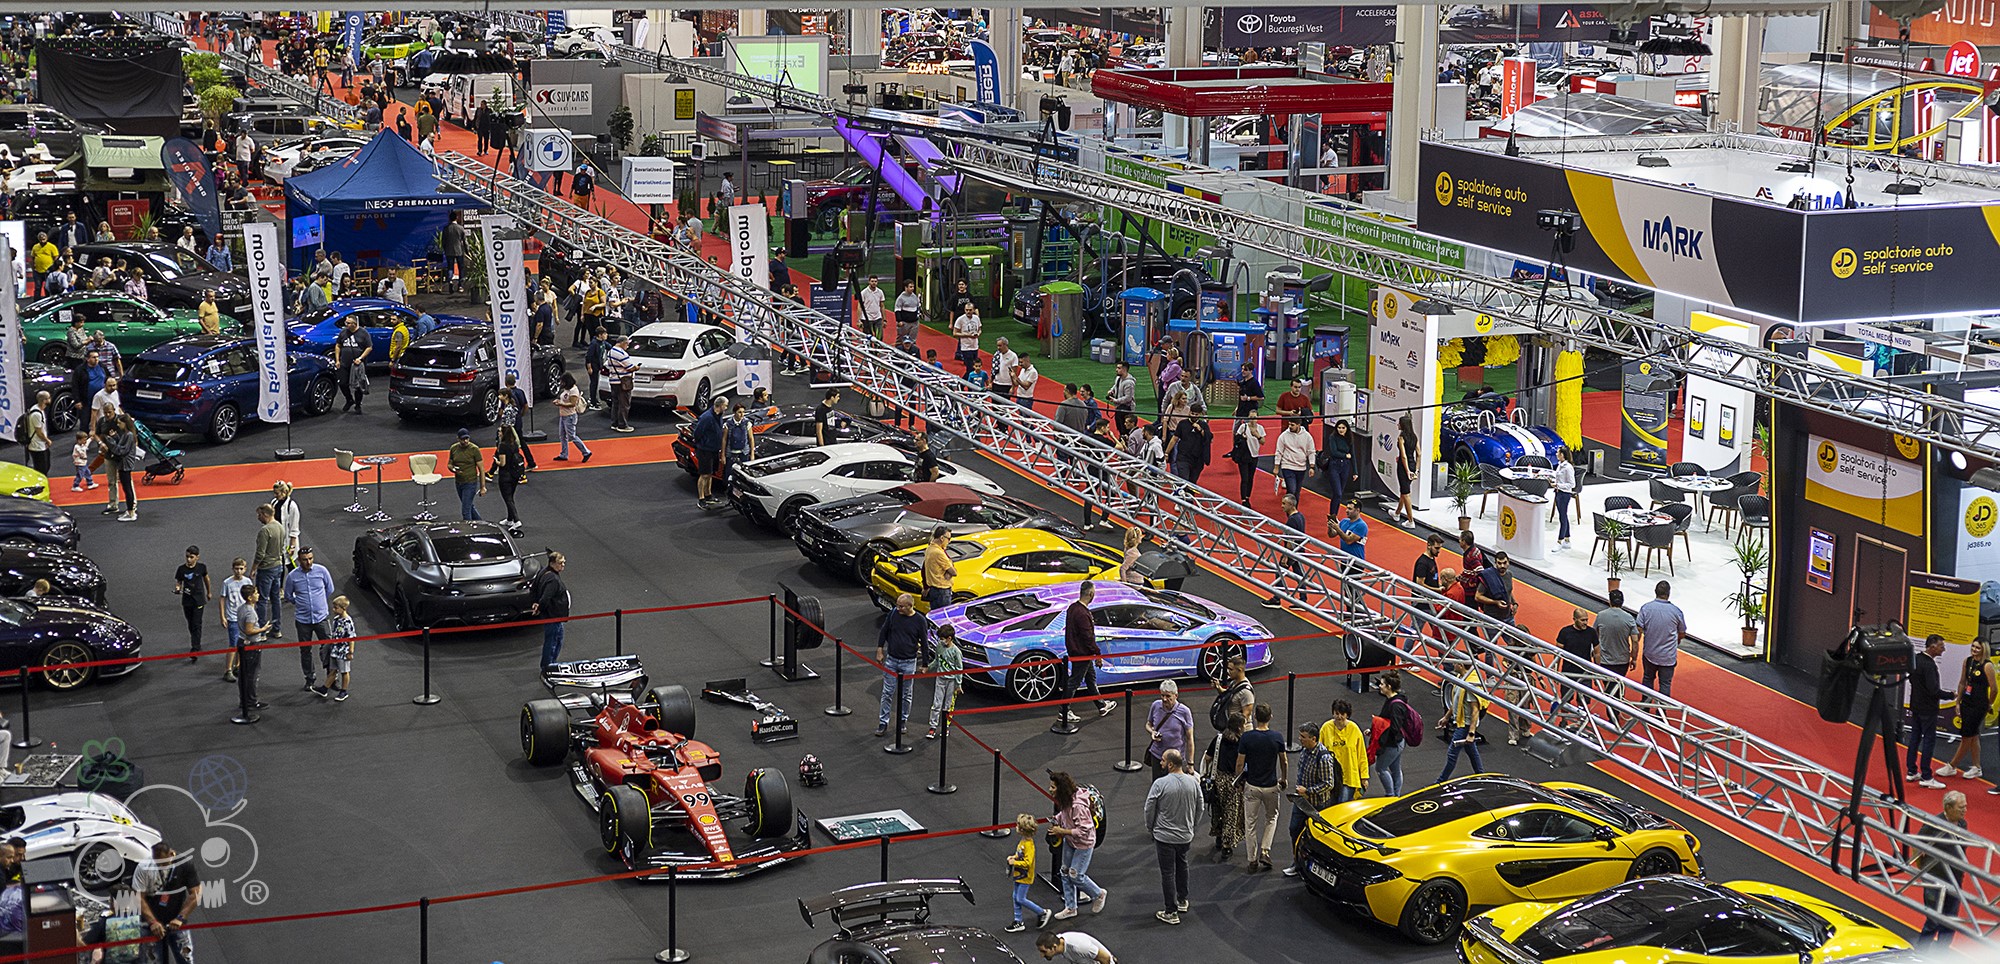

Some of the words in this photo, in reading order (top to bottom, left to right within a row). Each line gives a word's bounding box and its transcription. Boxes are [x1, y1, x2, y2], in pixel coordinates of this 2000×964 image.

[1269, 14, 1296, 24] Toyota
[1268, 24, 1304, 34] București
[1306, 24, 1323, 33] Vest
[1949, 50, 1975, 75] jet
[541, 136, 565, 146] BMW
[1107, 158, 1122, 174] Lnia
[1124, 163, 1132, 176] de
[1457, 178, 1502, 198] spalatorie
[1505, 186, 1528, 203] auto
[365, 200, 394, 210] INEOS
[397, 198, 455, 207] GRENADIER
[1457, 195, 1475, 209] self
[1477, 201, 1512, 217] service
[1308, 209, 1329, 226] Linia
[1331, 214, 1342, 228] de
[1381, 229, 1411, 246] pentru
[1643, 214, 1704, 262] MARK
[1925, 243, 1953, 257] auto
[1862, 261, 1887, 275] self
[1890, 260, 1934, 274] service
[1840, 452, 1876, 470] spalatorii
[1839, 465, 1856, 476] self
[1967, 541, 1992, 550] jd365.ro
[578, 659, 629, 672] racebox
[1145, 656, 1160, 666] Andy
[758, 723, 794, 735] HaasCNC.com
[682, 792, 710, 809] 99
